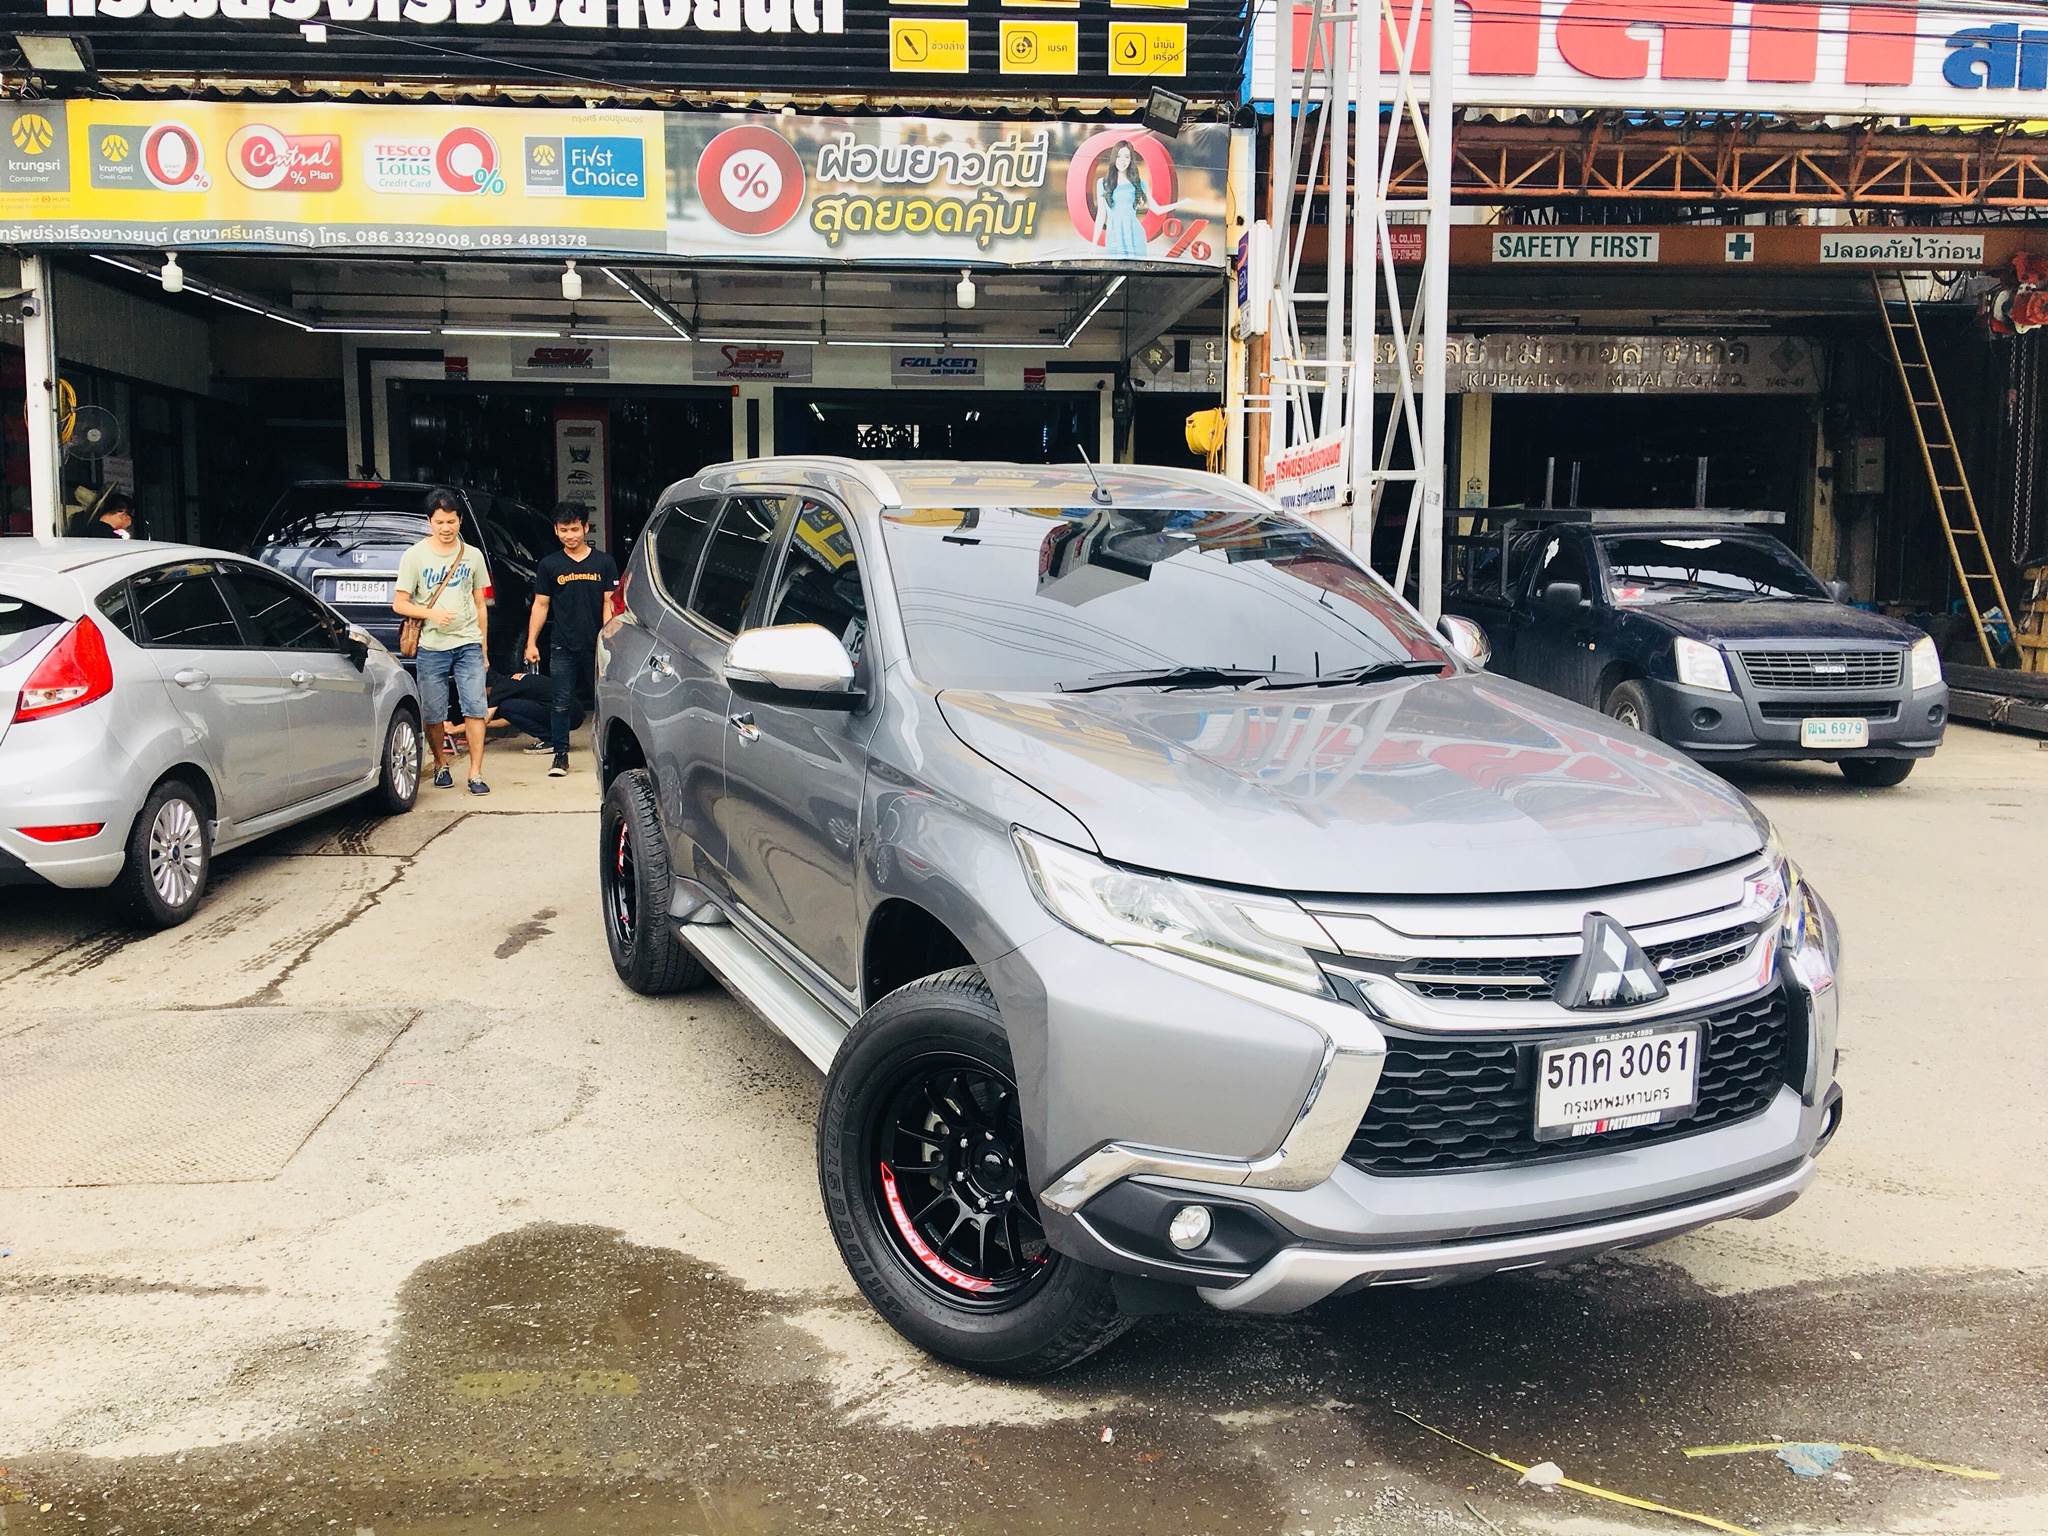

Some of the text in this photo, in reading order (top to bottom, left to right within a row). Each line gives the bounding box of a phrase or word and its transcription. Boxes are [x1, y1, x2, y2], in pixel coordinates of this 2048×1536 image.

[250, 141, 334, 168] Central
[374, 145, 431, 156] TESCO
[8, 160, 60, 172] krungsri
[819, 133, 1045, 185] ผ่อนยาวที่นี่
[99, 164, 134, 173] krungsri
[310, 171, 334, 180] Plan
[378, 161, 431, 176] Lotus
[9, 175, 50, 183] Consumer
[379, 178, 431, 188] Credit Card
[571, 168, 639, 187] Choice
[815, 194, 1036, 246] สุดยอดคุ้ม!
[319, 227, 351, 244] โทร.
[356, 231, 389, 243] 086
[394, 231, 475, 248] 3329008,
[480, 234, 513, 246] 089
[518, 233, 587, 247] 4891378
[1499, 235, 1653, 258] SAFETY FIRST
[1823, 237, 1983, 262] ปลอดภัยไว้ก่อน
[901, 357, 978, 368] FALKEN
[1468, 373, 1597, 387] KIJPHAIBOON
[557, 572, 598, 585] Continental
[1814, 665, 1846, 673] ISUZU
[1831, 722, 1862, 735] 6979
[1547, 1036, 1689, 1090] 5กค 3061
[1563, 1086, 1671, 1119] กรุงเทพมหานคร
[927, 1260, 976, 1288] FLOW
